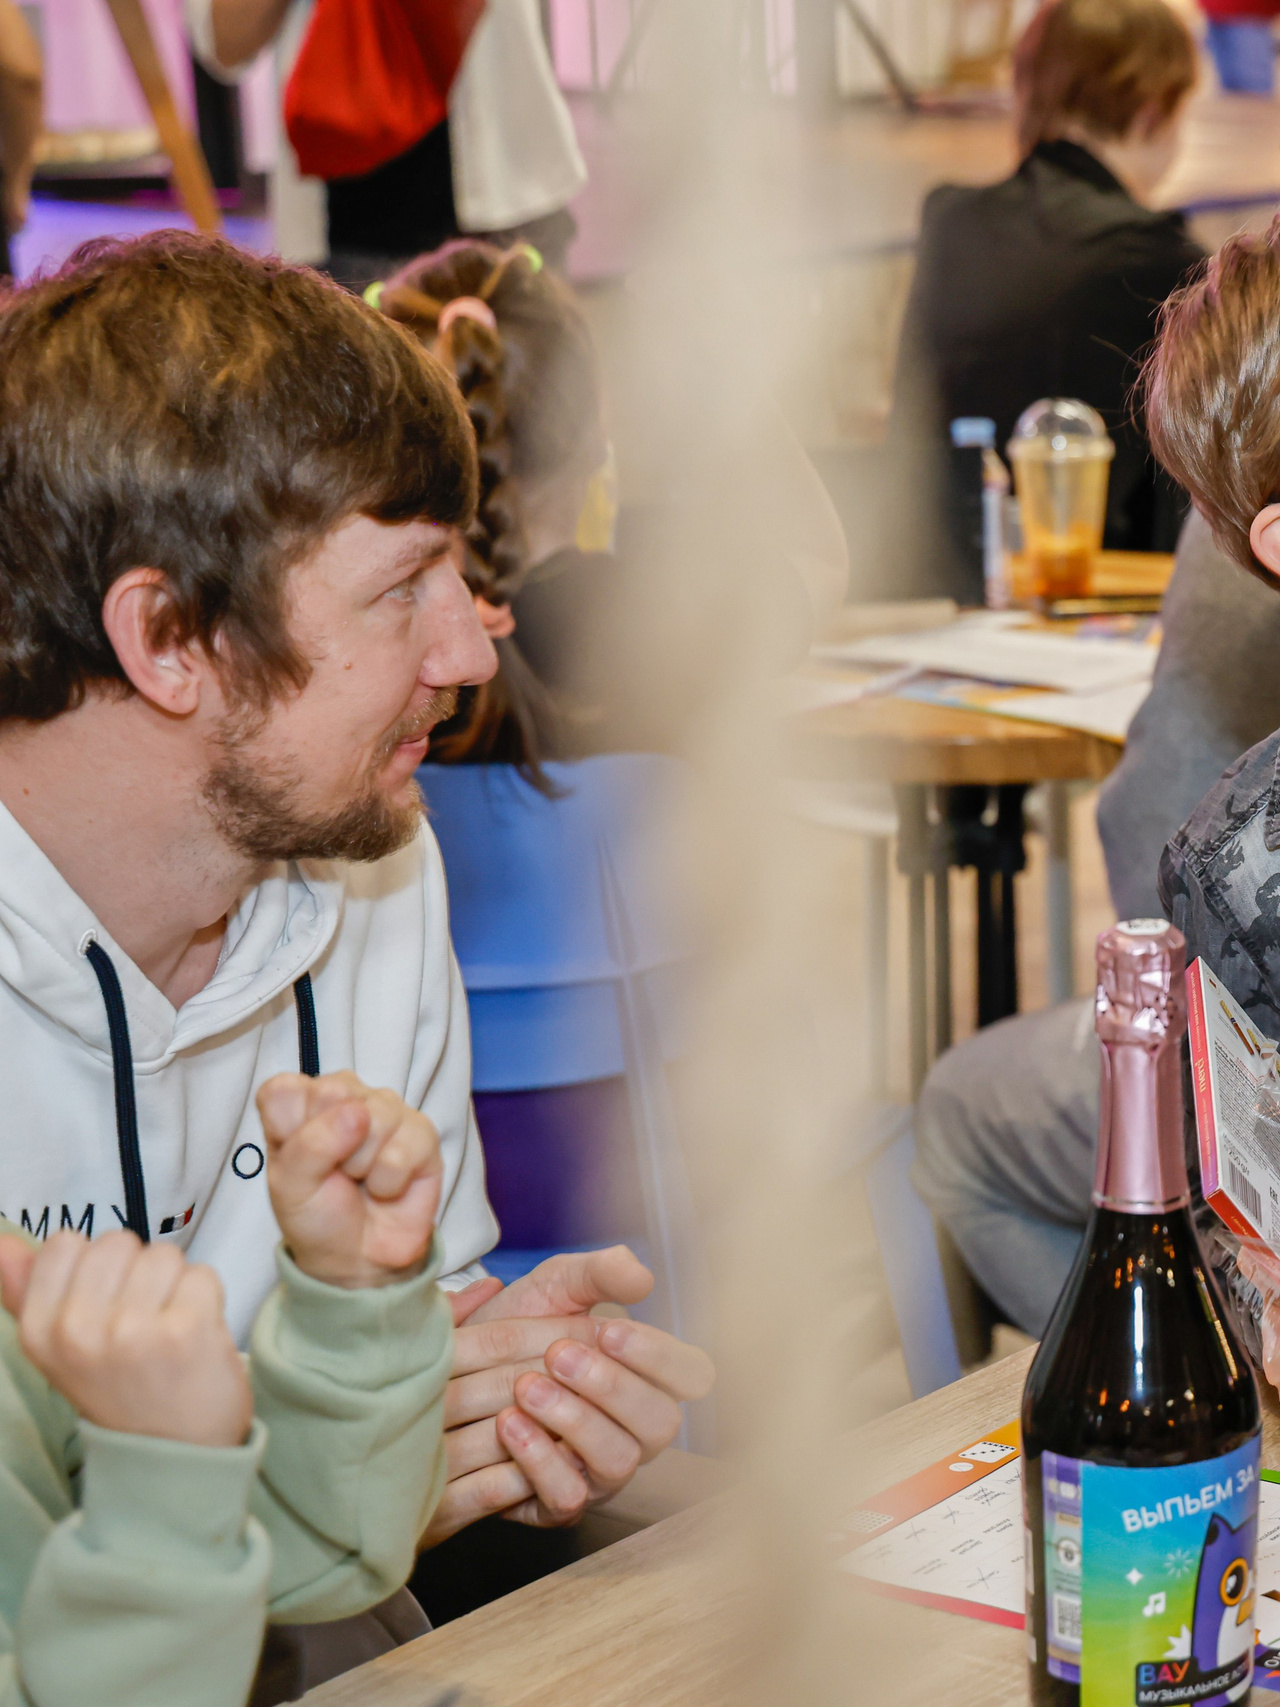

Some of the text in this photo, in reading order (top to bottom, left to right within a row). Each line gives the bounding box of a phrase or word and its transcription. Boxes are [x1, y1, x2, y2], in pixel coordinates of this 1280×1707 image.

[1194, 1057, 1207, 1093] merci
[1122, 1464, 1255, 1533] ВЫПЬЕМ ЗА
[1139, 1660, 1190, 1685] ВАУ
[1139, 1671, 1230, 1702] МУЗЫКАЛЬНОЕ
